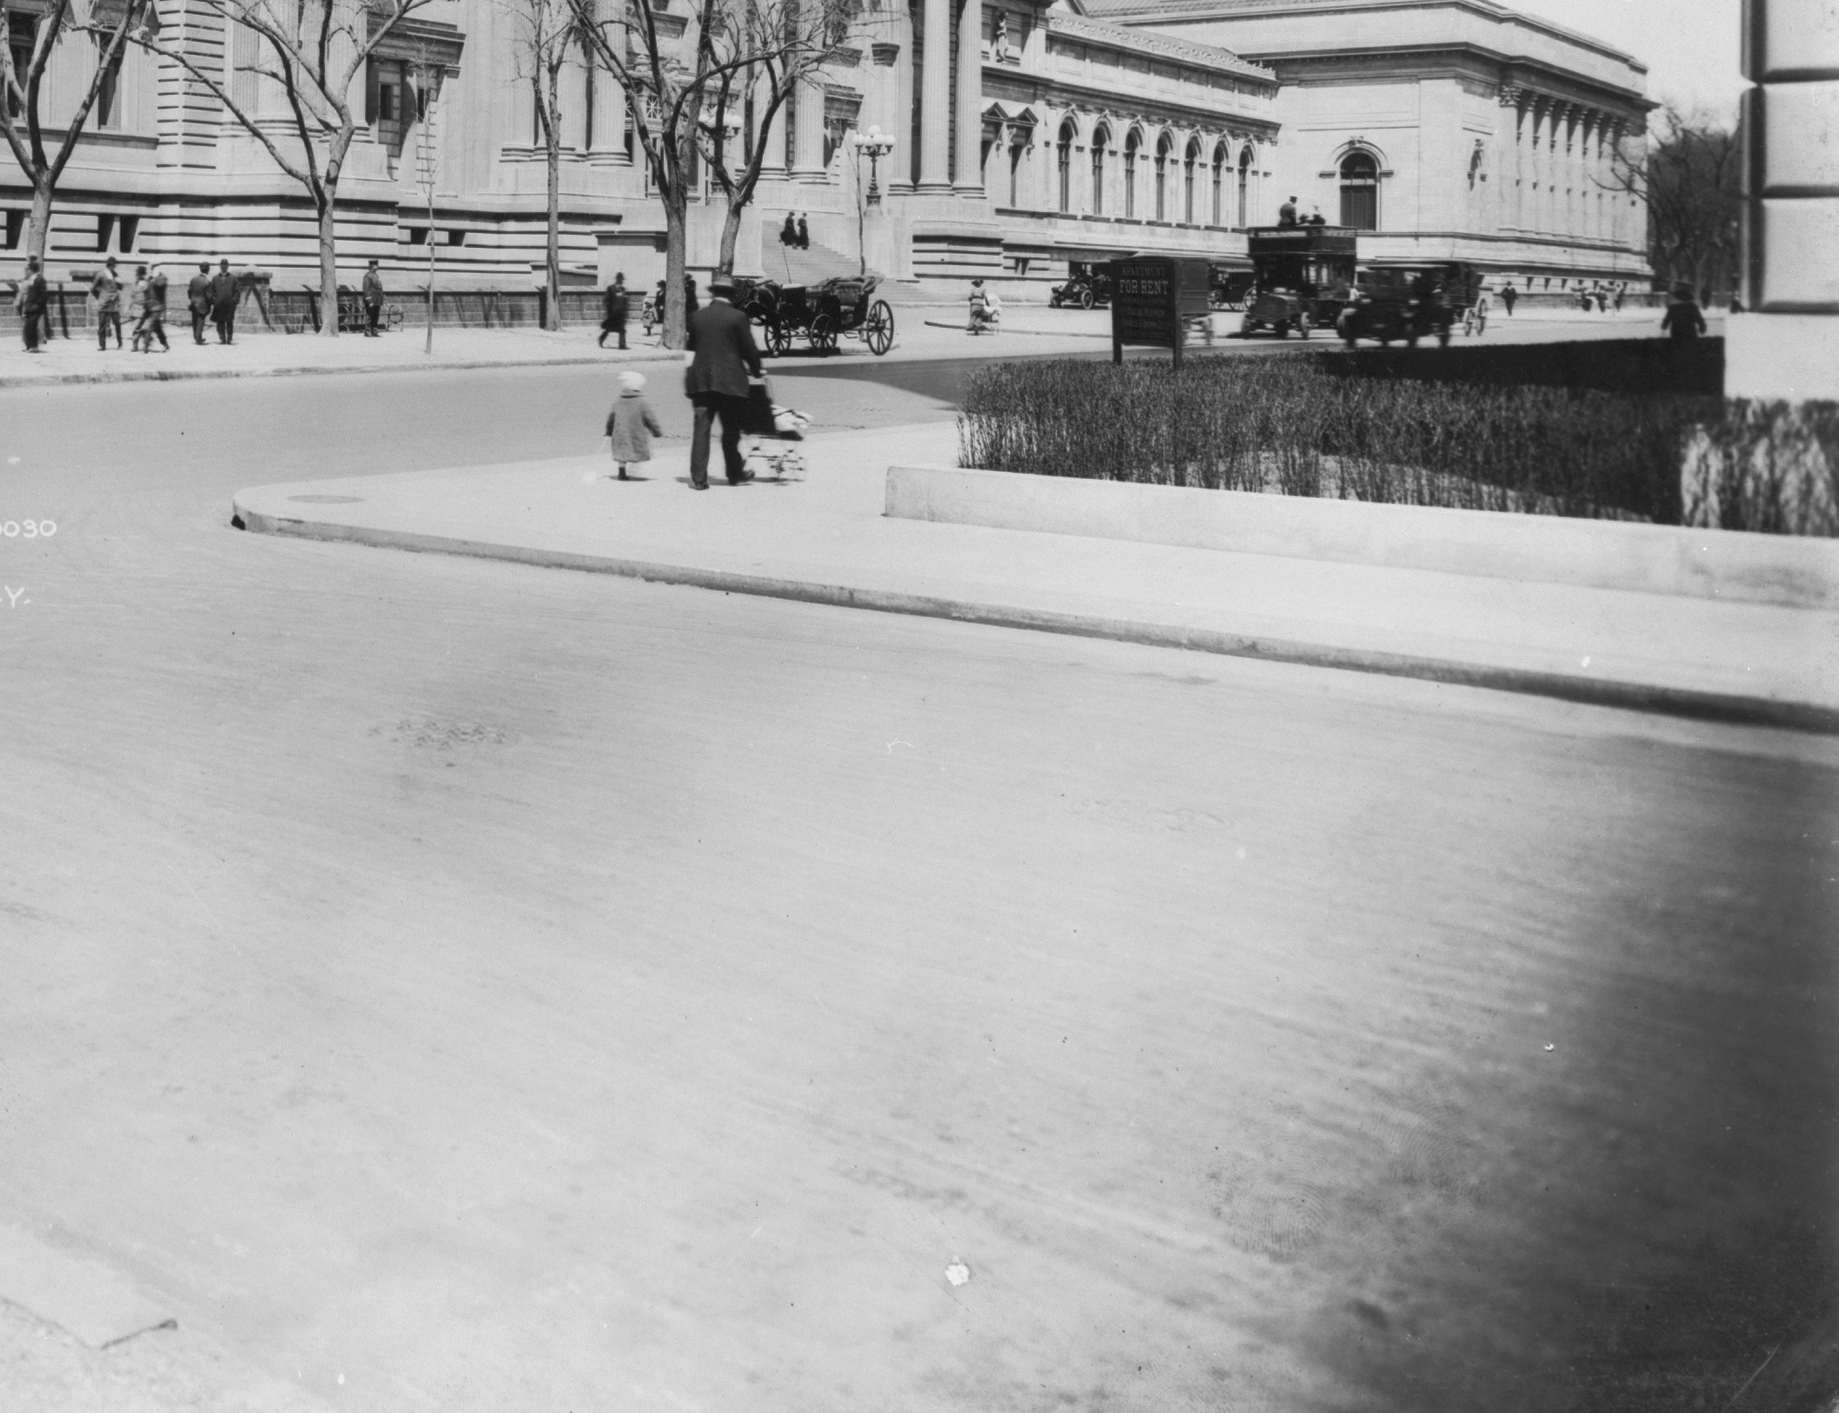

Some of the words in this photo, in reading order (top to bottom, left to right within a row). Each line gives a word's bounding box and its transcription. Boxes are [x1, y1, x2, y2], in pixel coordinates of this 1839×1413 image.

[1121, 266, 1166, 277] APARTMENT
[1119, 279, 1139, 294] FOR
[1140, 280, 1169, 295] RENT
